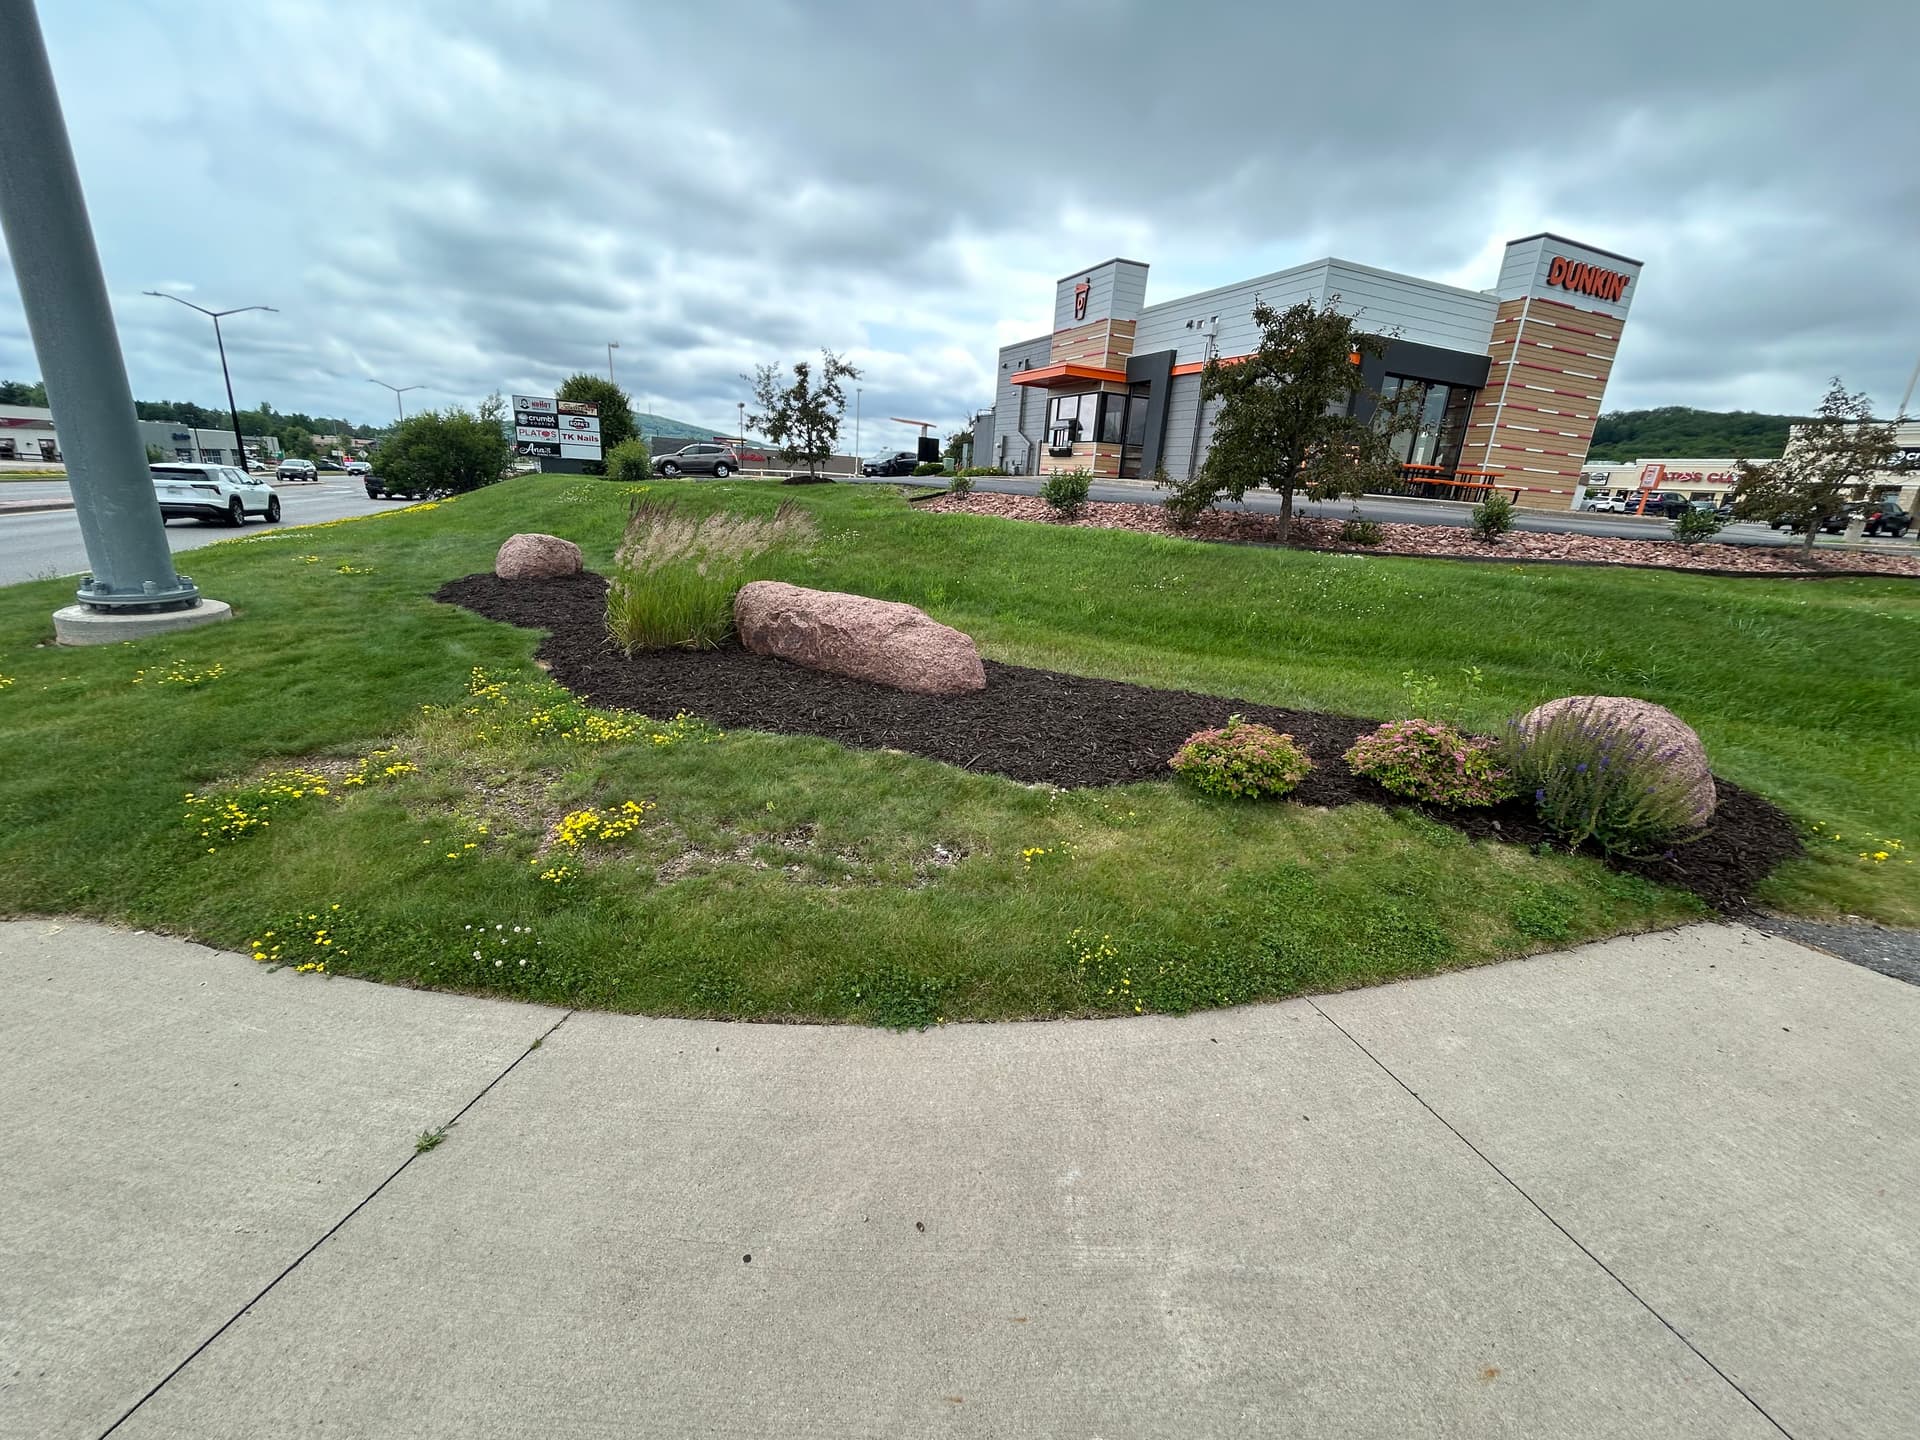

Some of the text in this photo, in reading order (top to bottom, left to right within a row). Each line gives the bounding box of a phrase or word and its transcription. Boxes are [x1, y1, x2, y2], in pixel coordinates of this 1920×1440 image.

[1547, 255, 1630, 302] DUNKIN'
[561, 433, 599, 442] TK Nails
